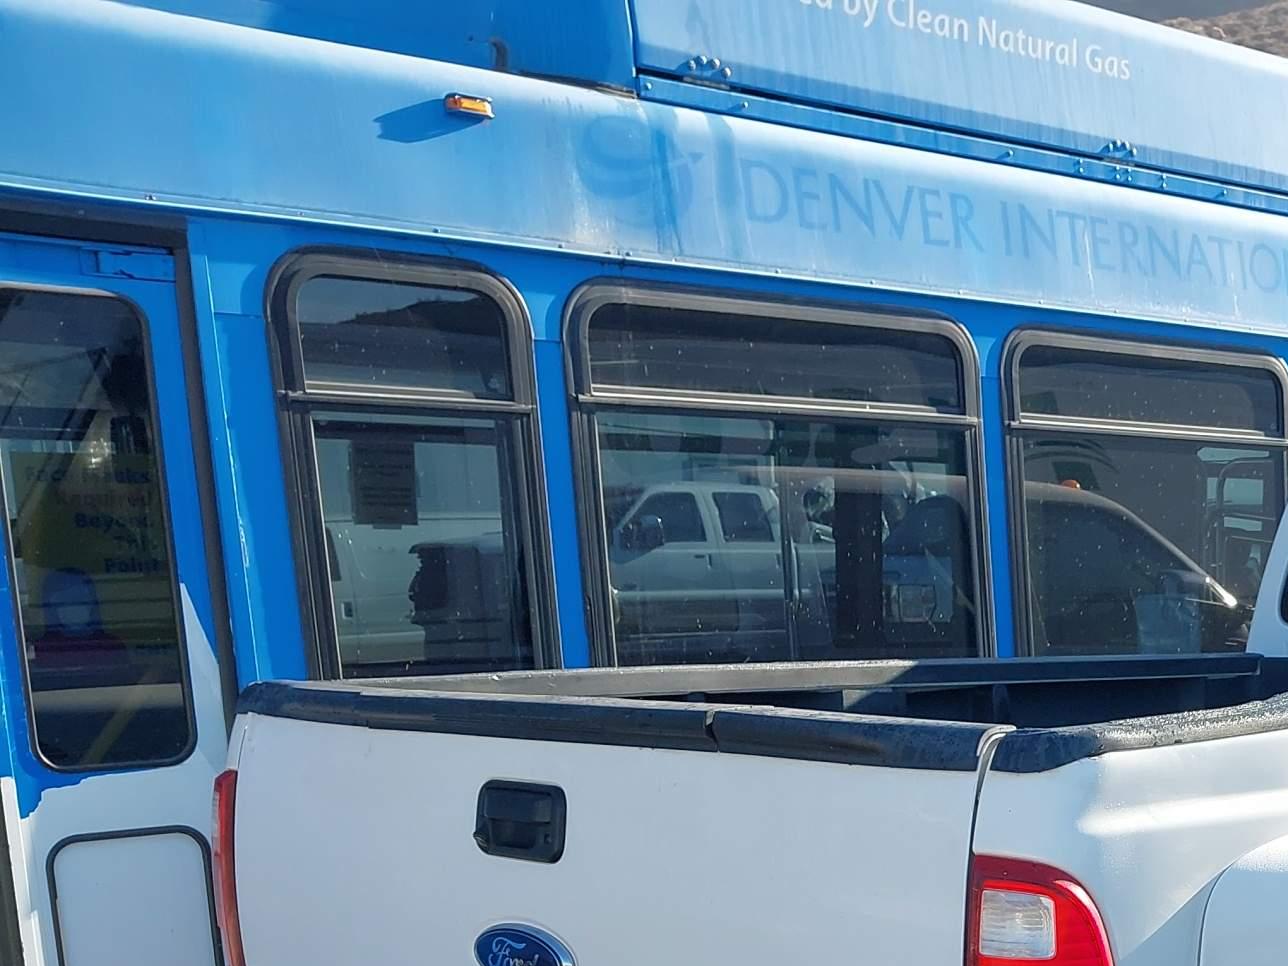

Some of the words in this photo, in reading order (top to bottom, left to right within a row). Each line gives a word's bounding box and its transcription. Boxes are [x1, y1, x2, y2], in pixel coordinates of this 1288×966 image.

[887, 0, 969, 42] Clean
[978, 16, 1077, 66] Natural
[1086, 45, 1131, 80] Gas
[748, 157, 985, 254] DENVER
